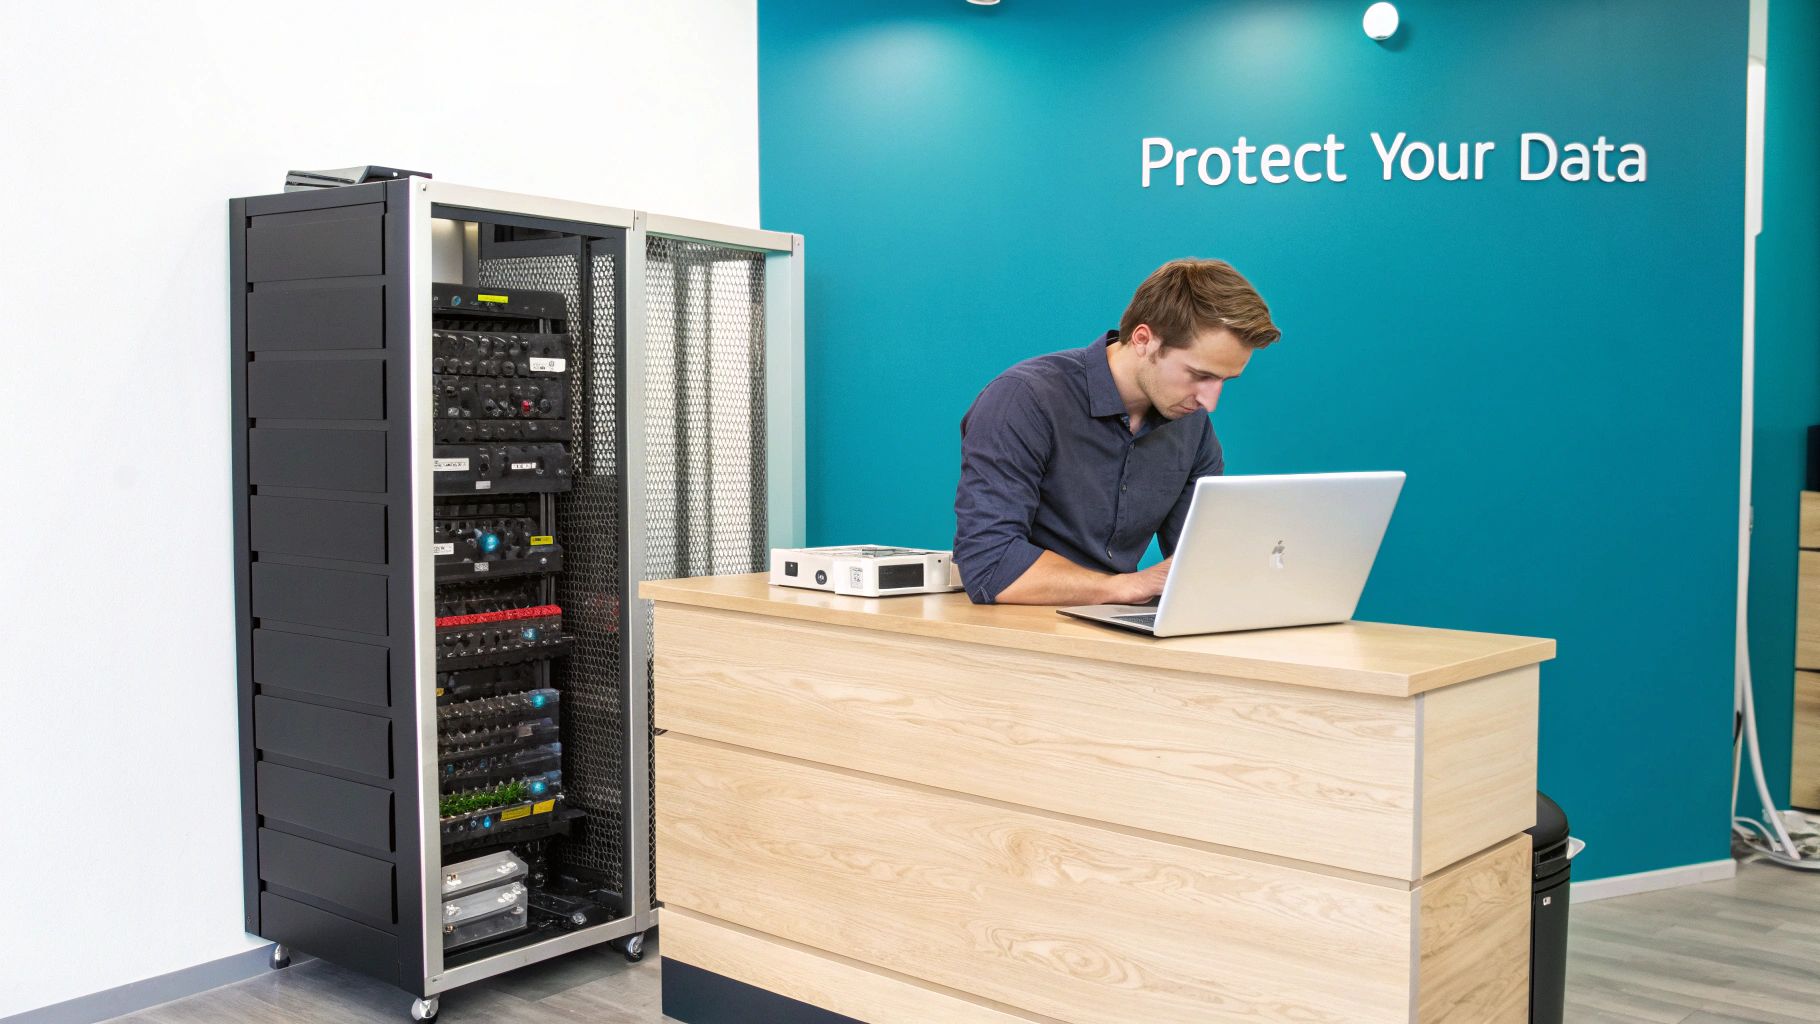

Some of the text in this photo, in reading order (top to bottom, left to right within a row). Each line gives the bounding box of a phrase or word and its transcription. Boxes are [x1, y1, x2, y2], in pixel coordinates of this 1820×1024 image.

[1141, 131, 1647, 187] Protect Your Data
